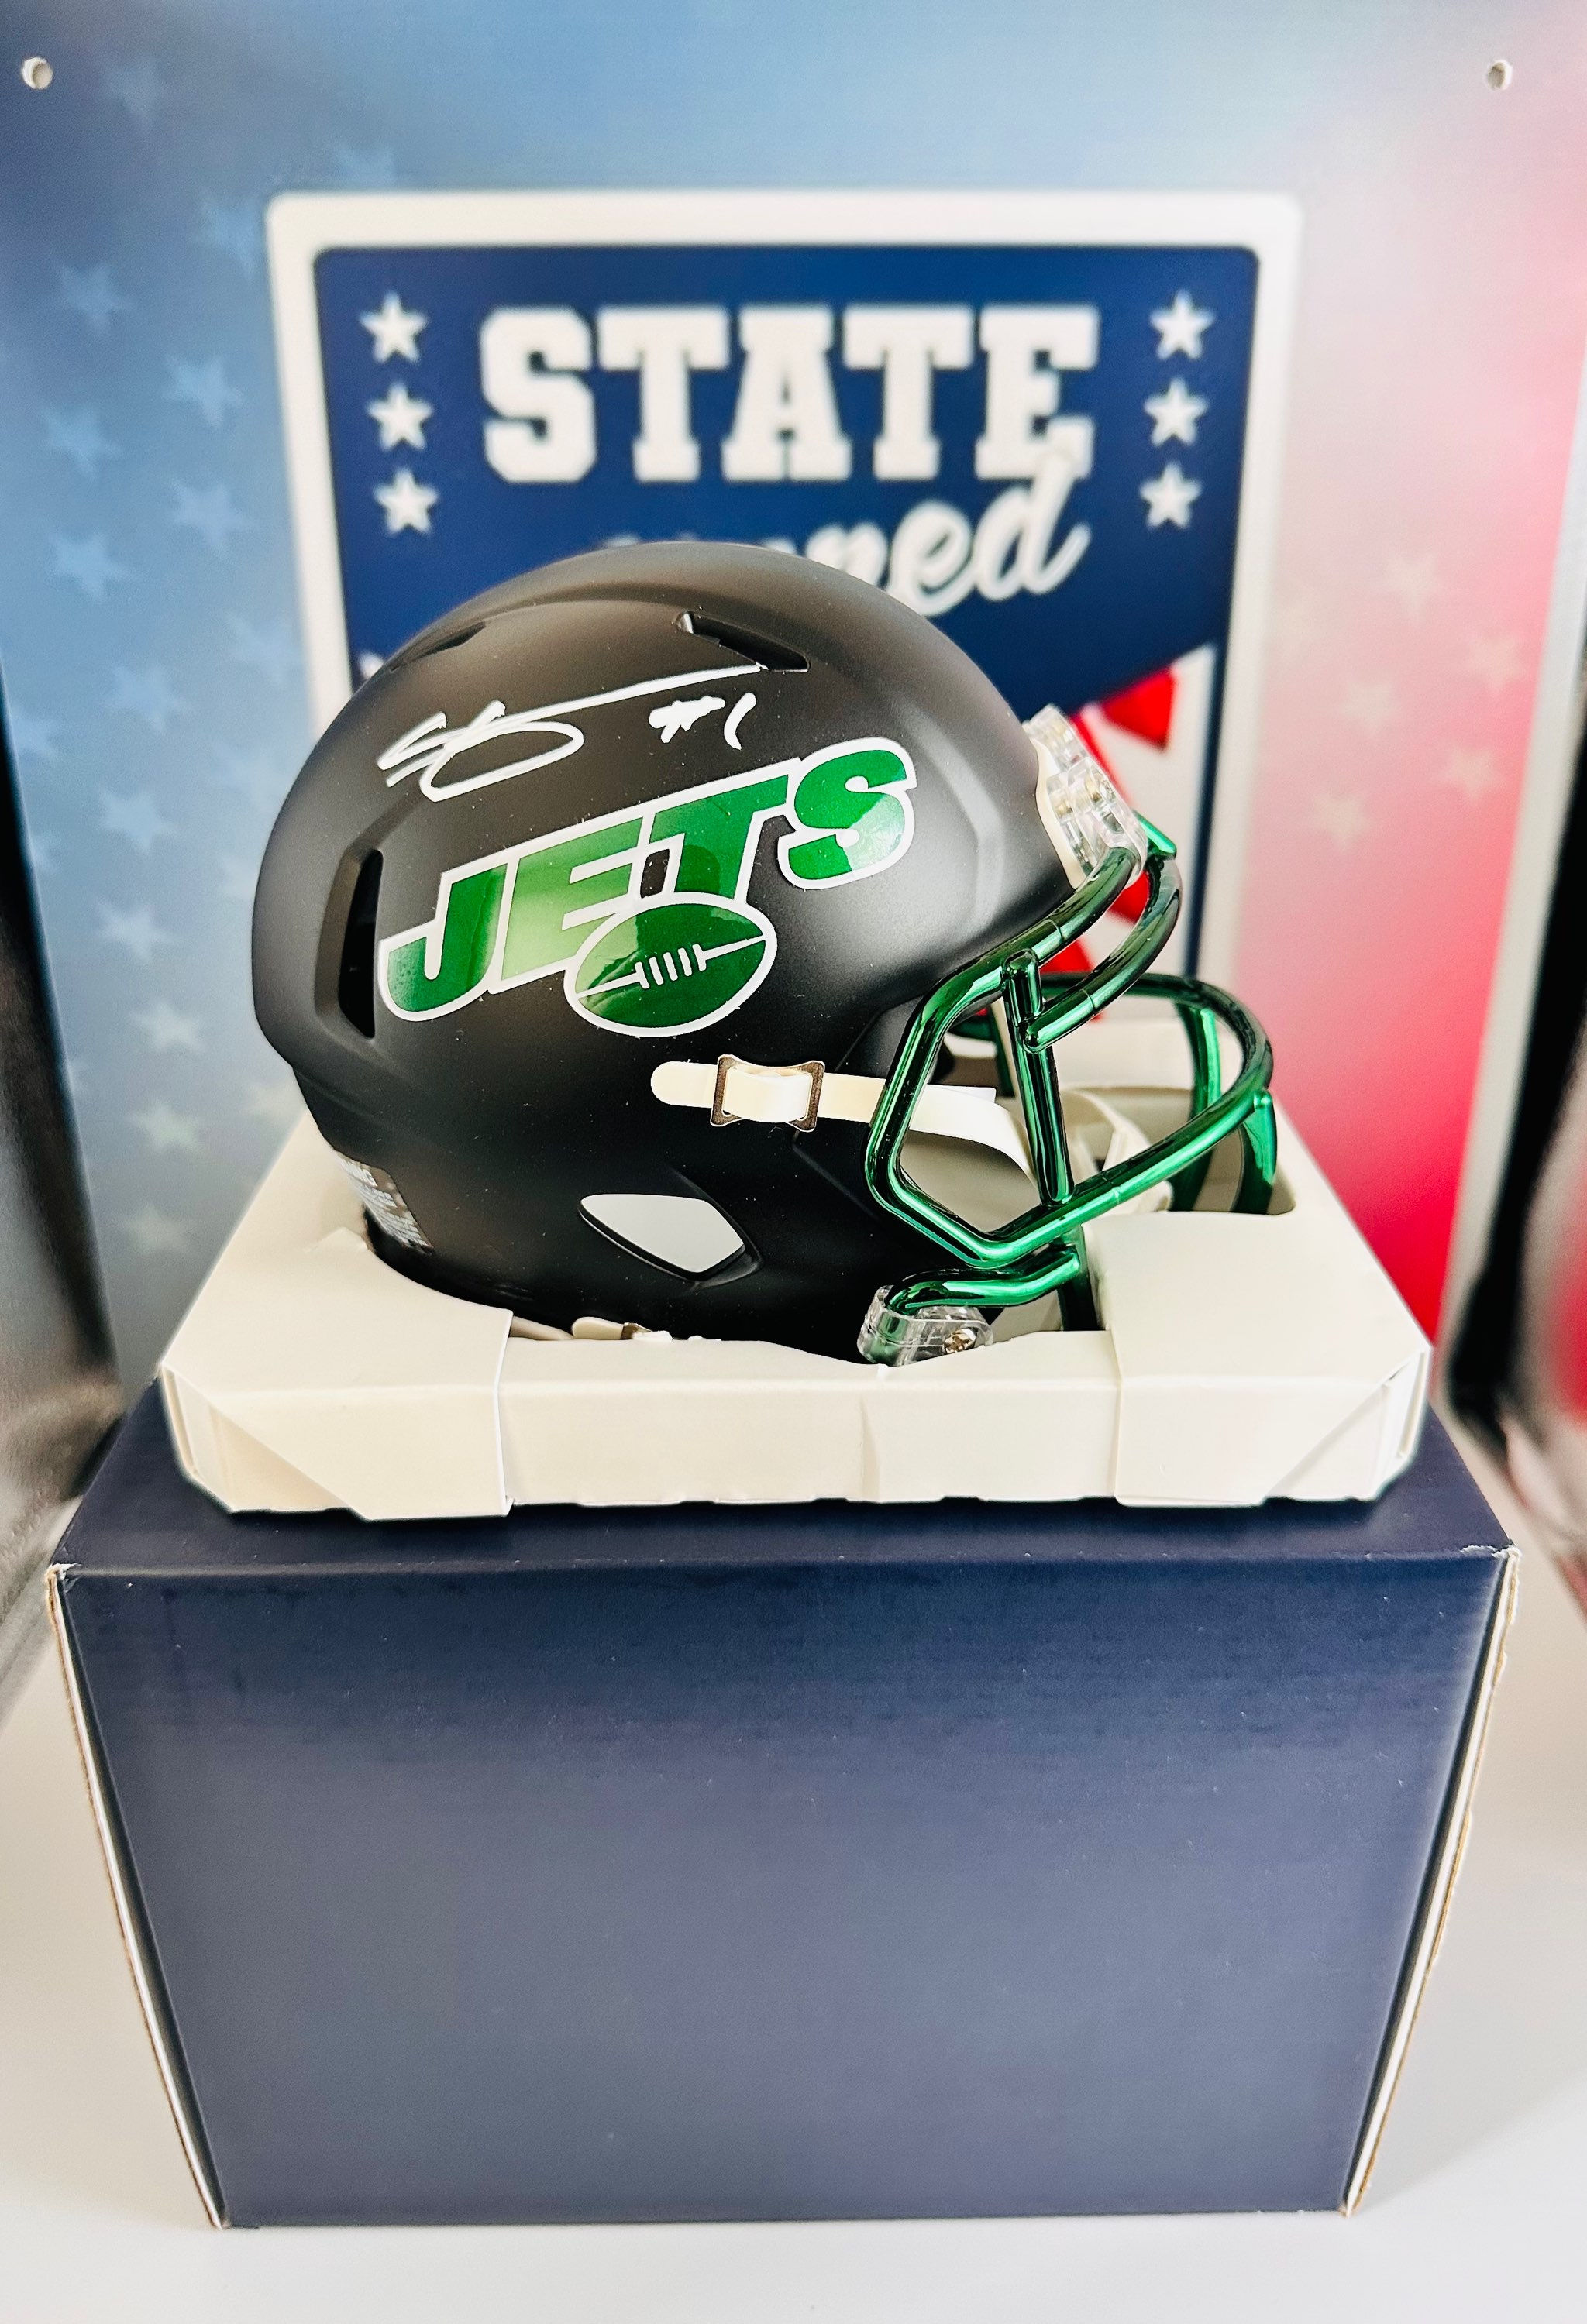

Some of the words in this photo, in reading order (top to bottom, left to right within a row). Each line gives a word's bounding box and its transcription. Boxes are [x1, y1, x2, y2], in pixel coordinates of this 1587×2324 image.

[480, 304, 1100, 483] STATE
[606, 446, 1091, 617] ned
[377, 736, 918, 1023] JETS
